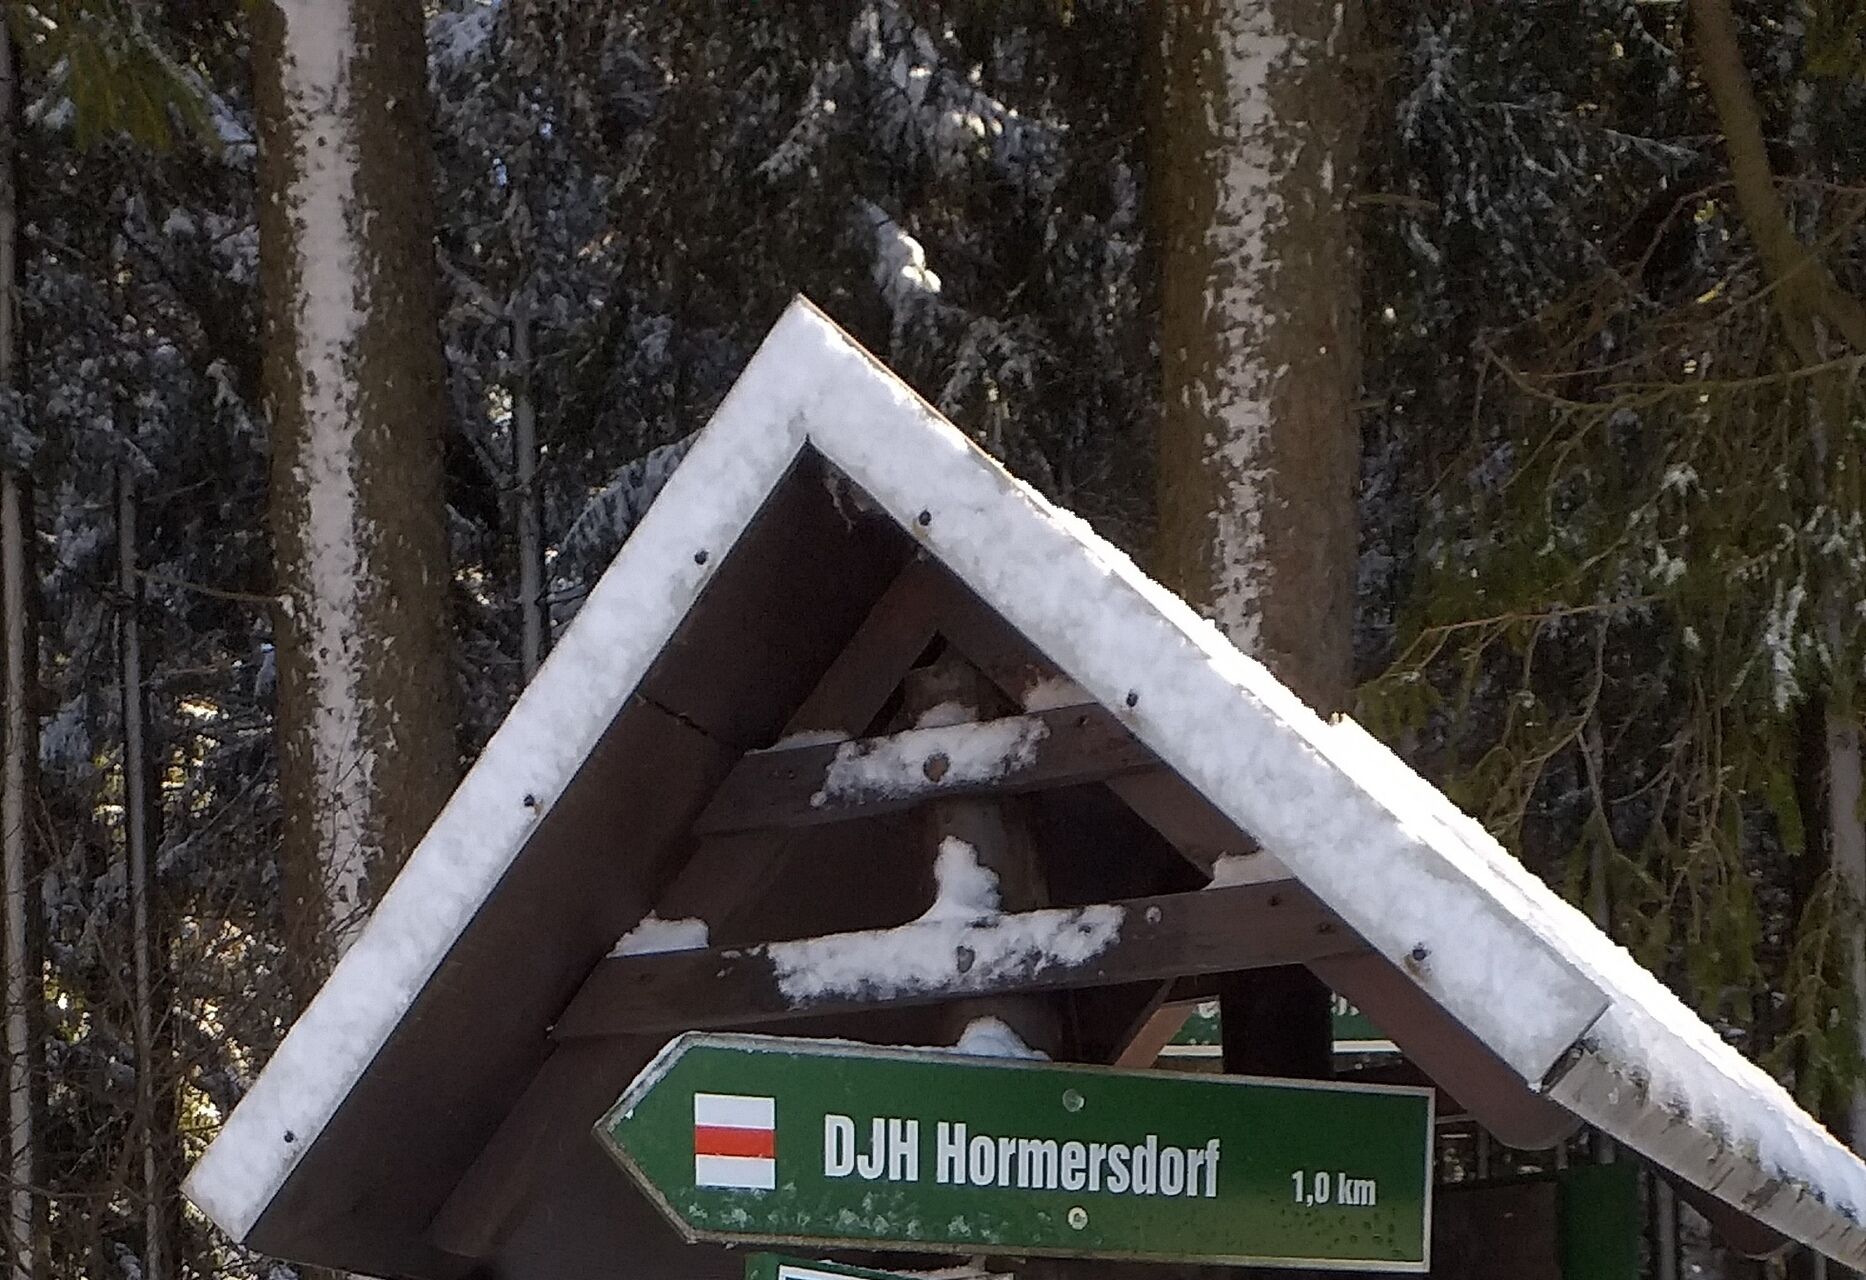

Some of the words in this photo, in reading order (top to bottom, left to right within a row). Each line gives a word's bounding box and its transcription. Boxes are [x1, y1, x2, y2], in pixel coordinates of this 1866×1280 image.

[825, 1114, 920, 1181] DJH
[937, 1120, 1221, 1198] Hormersdorf
[1292, 1170, 1330, 1206] 1,0
[1337, 1172, 1377, 1206] km
